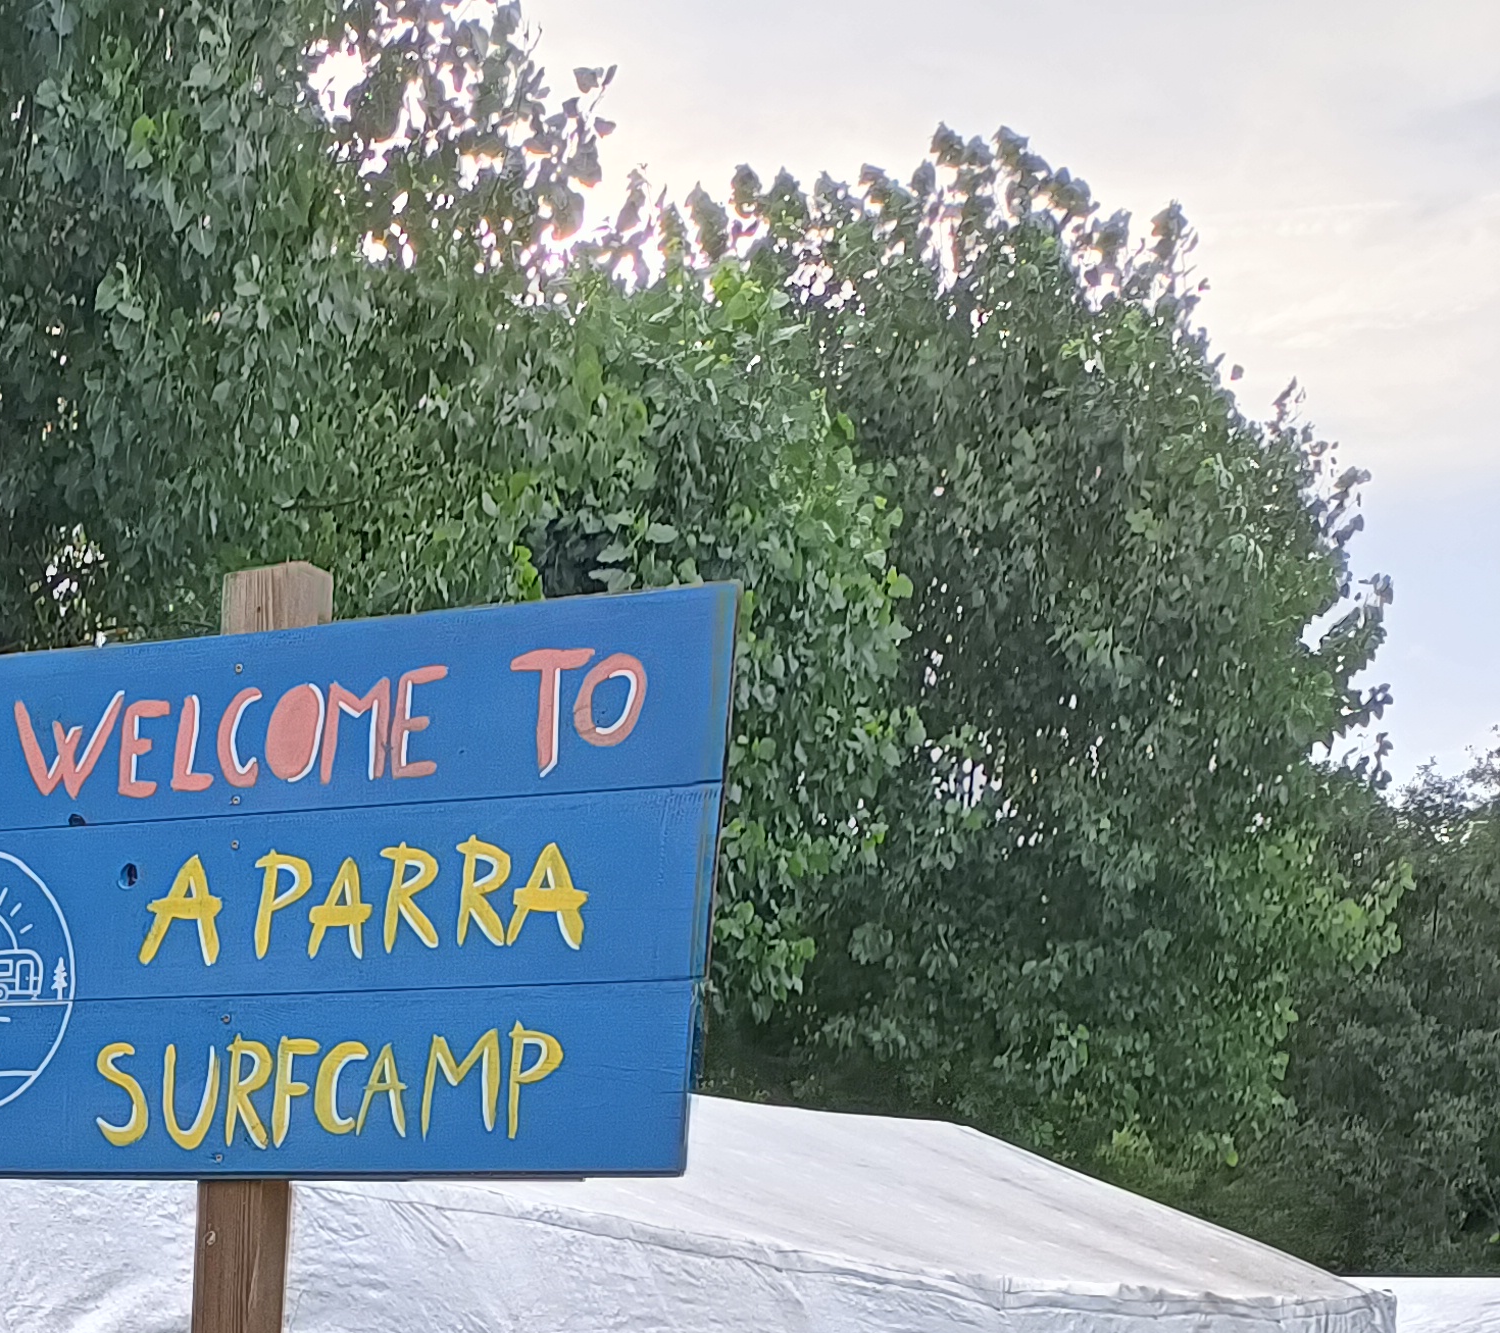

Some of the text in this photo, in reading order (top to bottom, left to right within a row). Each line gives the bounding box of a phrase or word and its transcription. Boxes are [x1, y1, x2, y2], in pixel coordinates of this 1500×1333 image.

[13, 647, 648, 799] WELCOME TO
[95, 1020, 565, 1150] SURFCAMP
